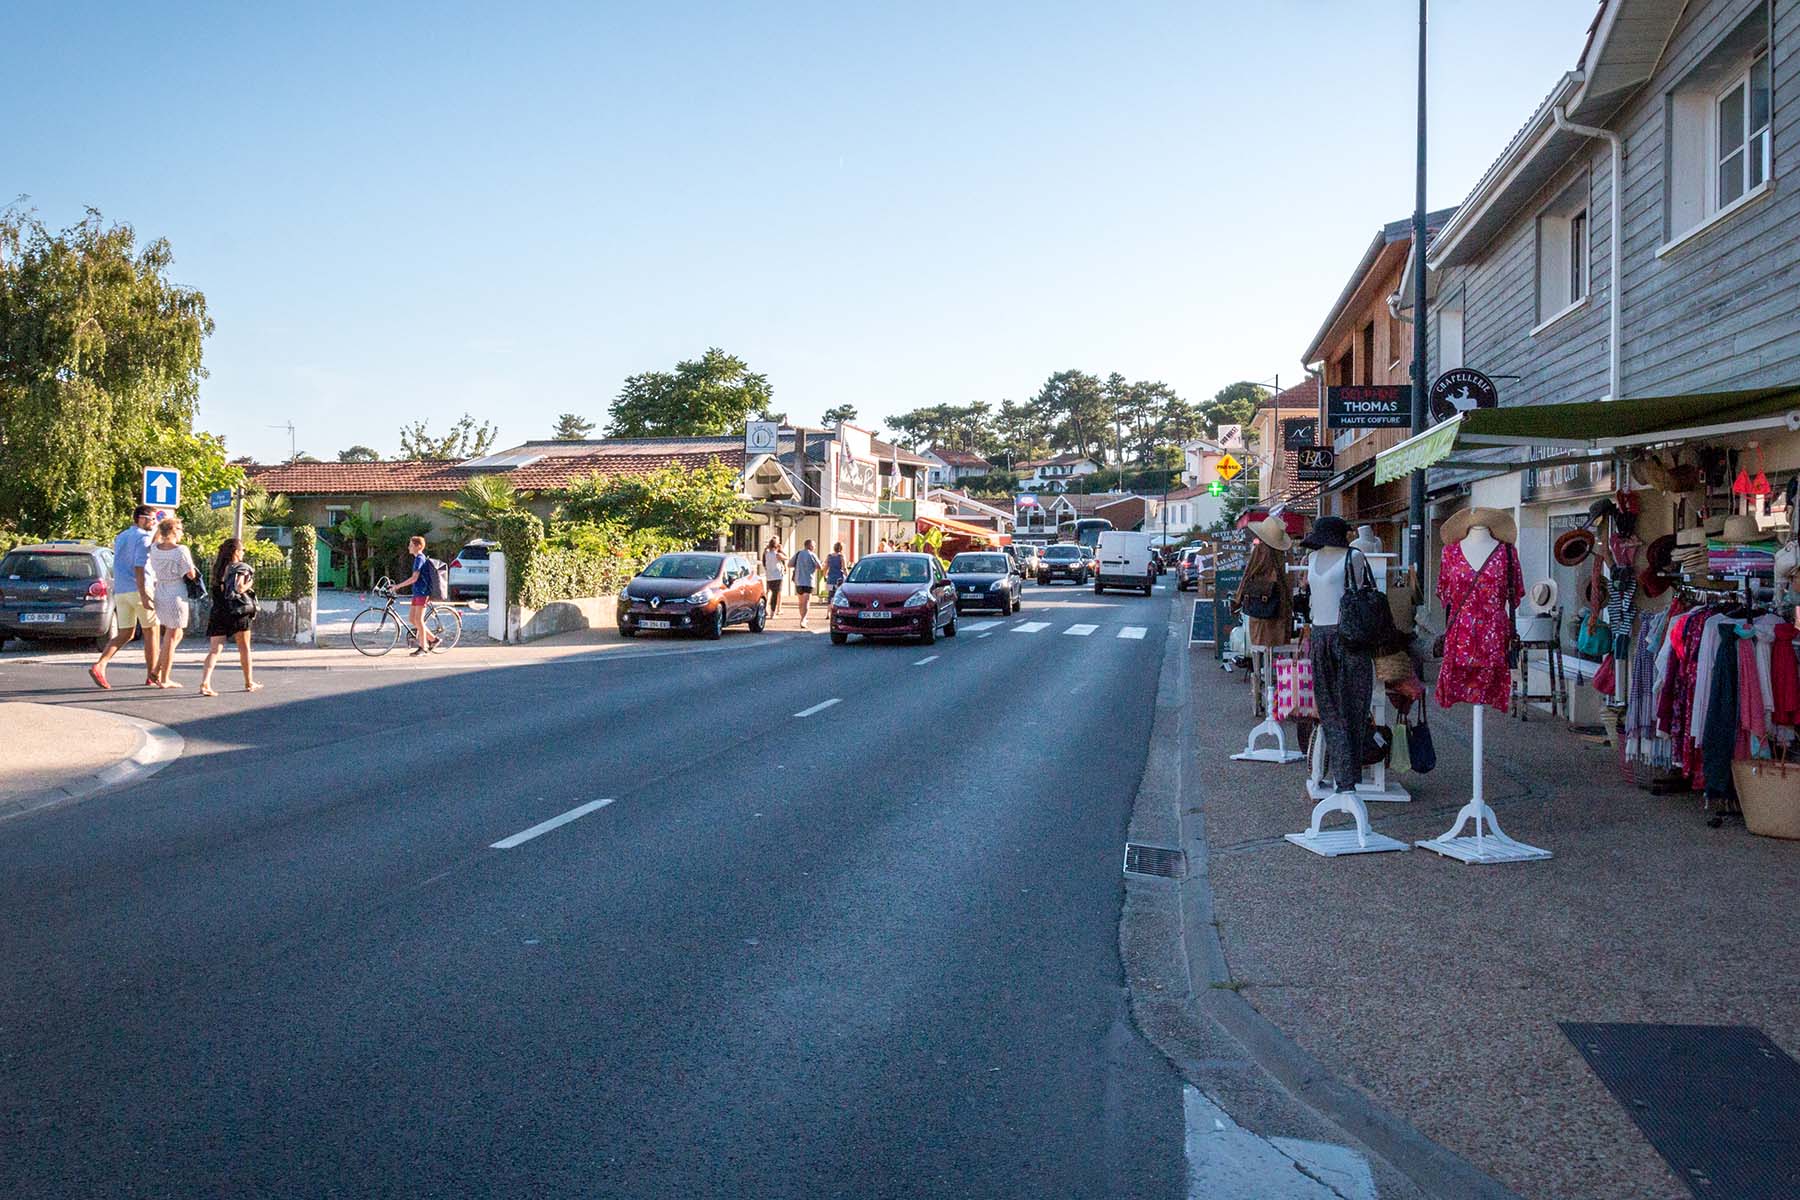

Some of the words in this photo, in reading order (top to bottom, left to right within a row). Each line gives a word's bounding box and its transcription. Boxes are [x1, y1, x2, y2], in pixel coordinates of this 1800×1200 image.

[1436, 374, 1490, 393] CHAPELLERIE
[1343, 401, 1398, 412] THOMAS
[1340, 416, 1366, 424] HAUTE
[1367, 416, 1401, 424] COIFFURE
